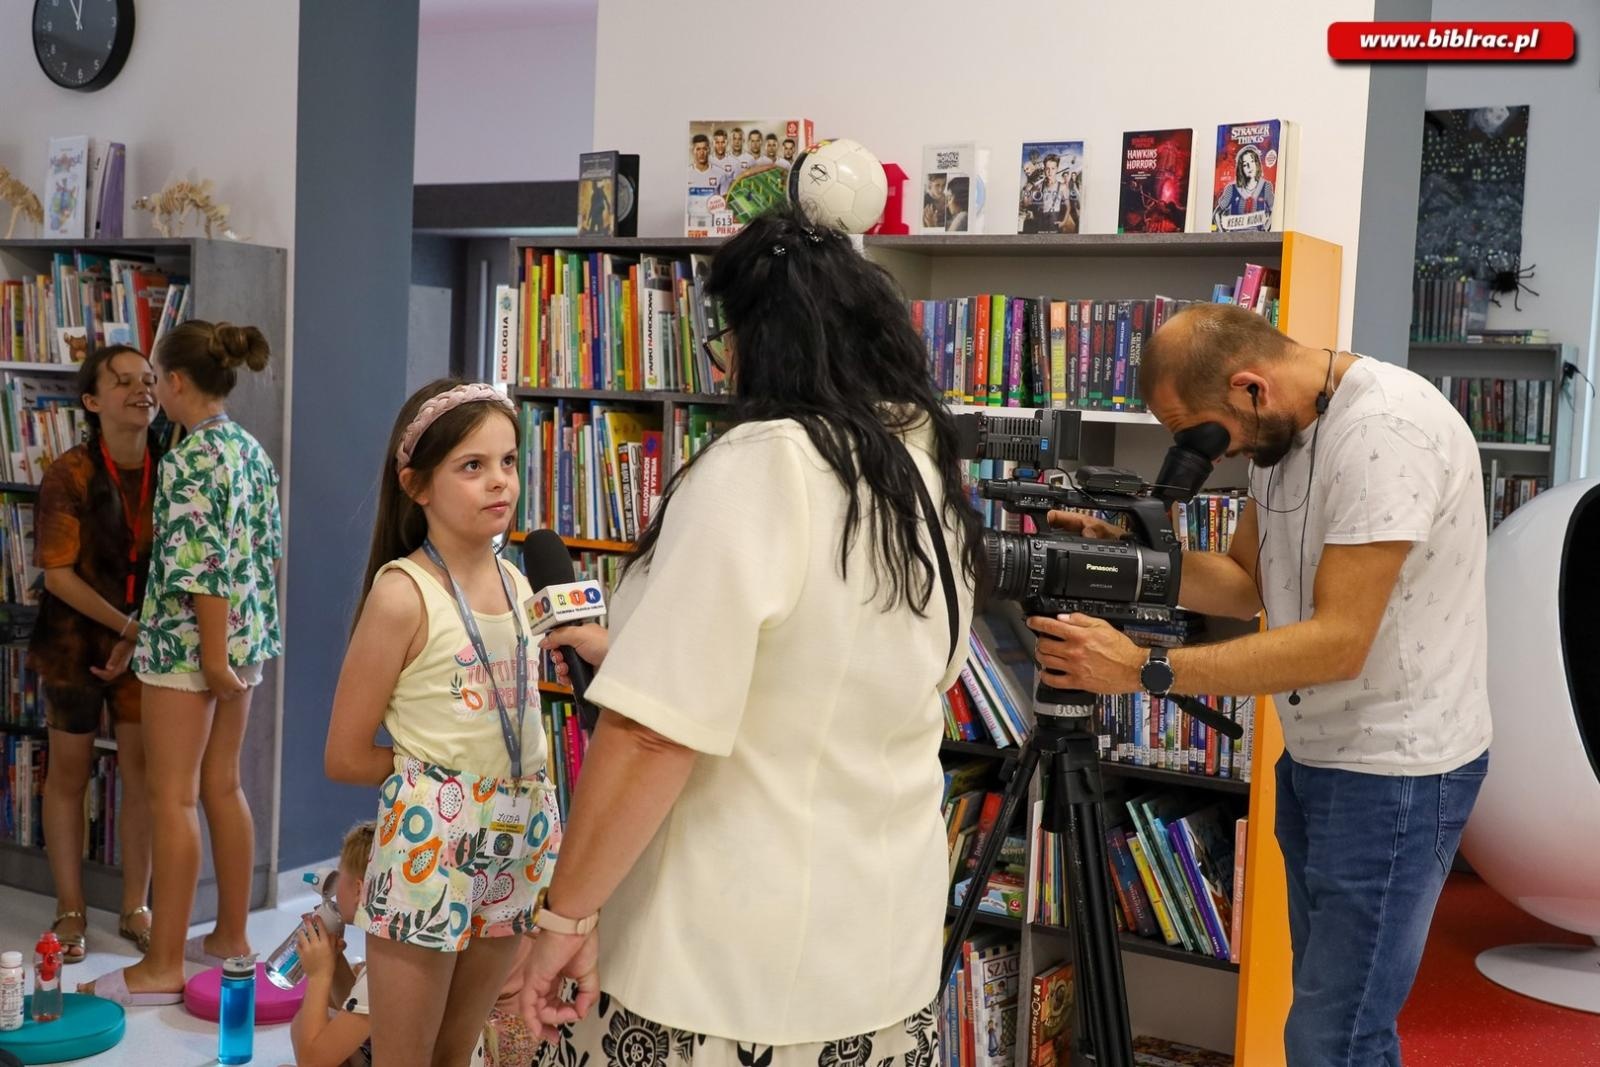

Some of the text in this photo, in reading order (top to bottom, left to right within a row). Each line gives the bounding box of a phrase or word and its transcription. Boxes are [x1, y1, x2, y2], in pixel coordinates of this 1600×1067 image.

[78, 68, 83, 80] 6
[1231, 124, 1270, 140] STRANGER
[1238, 135, 1265, 145] THINGS
[1127, 149, 1157, 160] HAWKINS
[1126, 159, 1157, 170] HORRORS
[501, 316, 509, 381] EKOLOGIA
[642, 457, 650, 516] KOSZYKÓWKI
[1085, 563, 1119, 573] Panasonic
